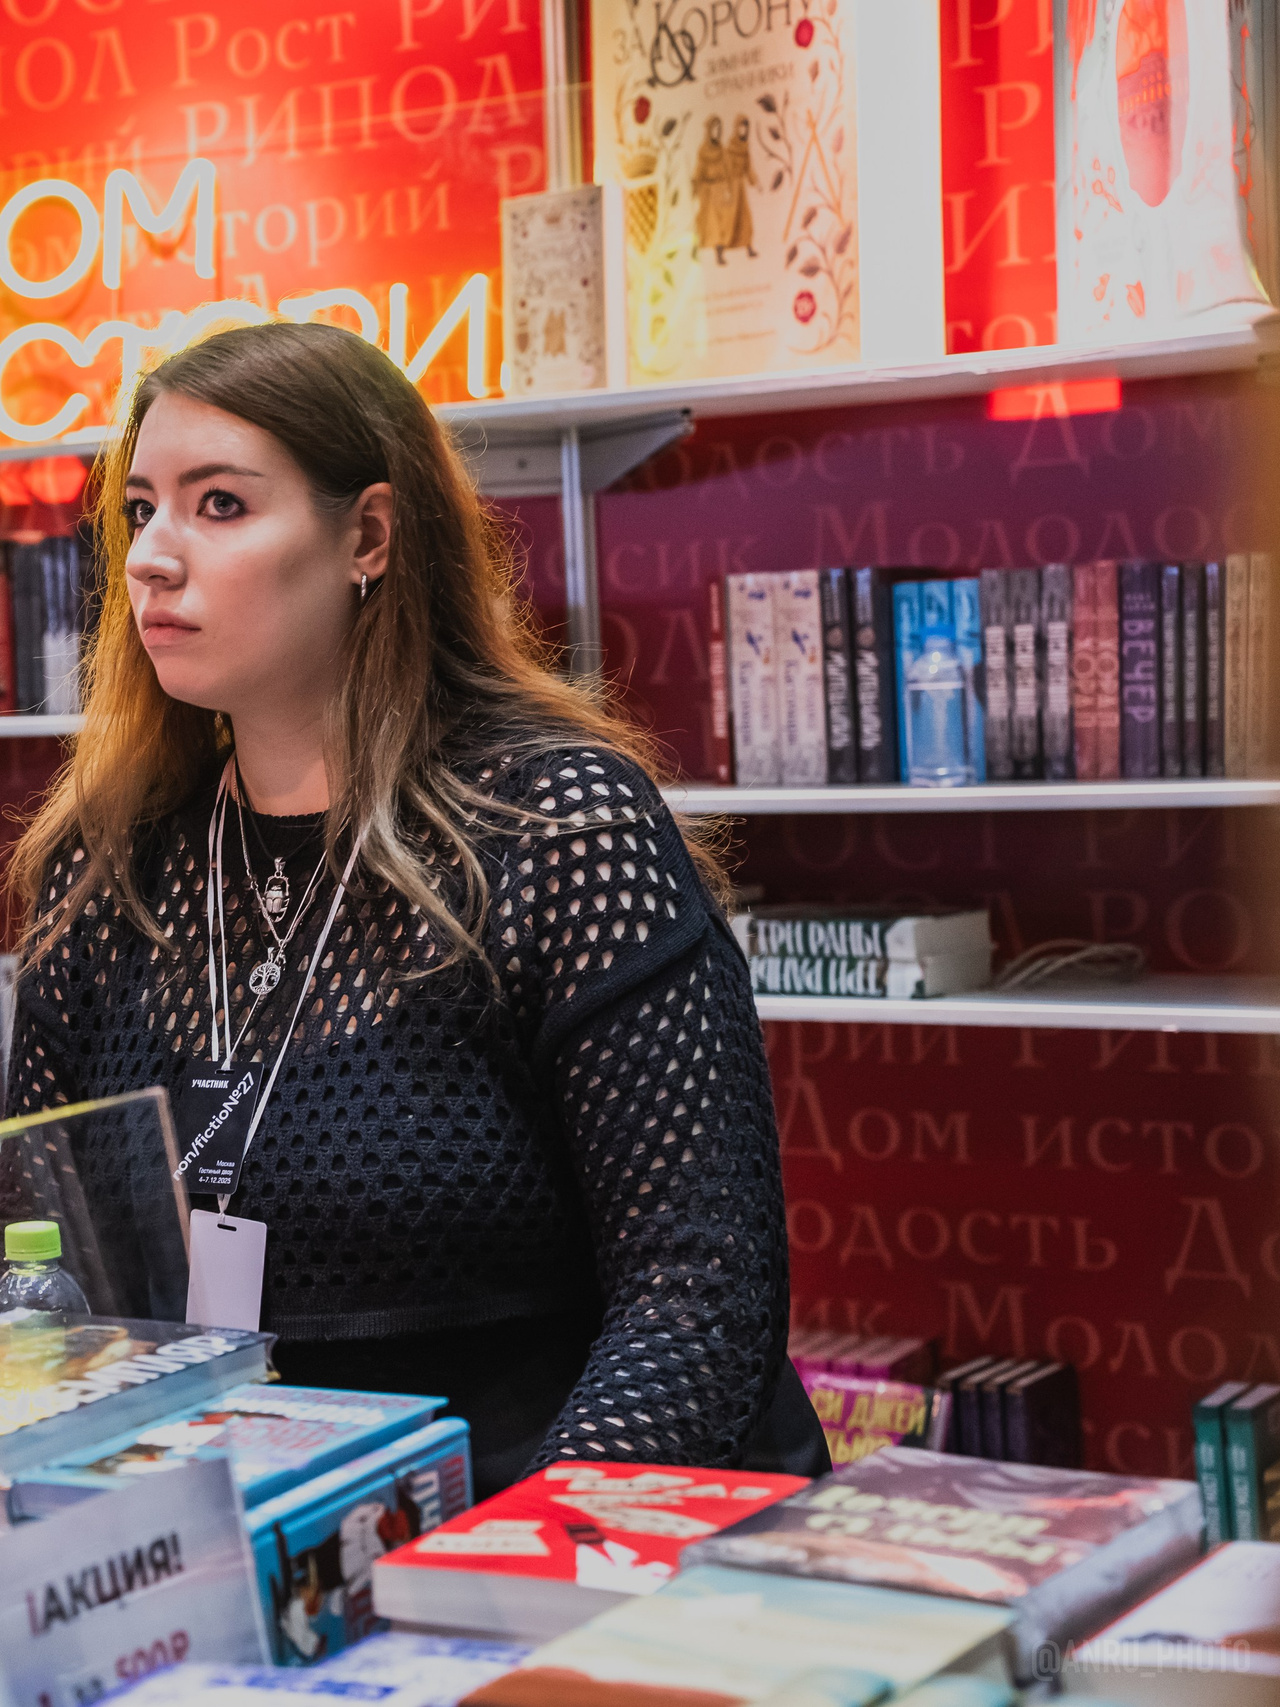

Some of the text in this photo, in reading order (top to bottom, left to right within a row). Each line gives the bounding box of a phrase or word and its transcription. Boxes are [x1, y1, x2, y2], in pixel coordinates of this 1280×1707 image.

[169, 11, 357, 88] Рост
[175, 50, 536, 168] РИПОЛ
[1010, 382, 1233, 487] Дом
[1122, 619, 1157, 723] ВЕЧЕР
[757, 919, 803, 956] ТРИ
[191, 1079, 230, 1089] УЧАСТНИК
[779, 1074, 975, 1173] Дом
[216, 1160, 235, 1168] Москва
